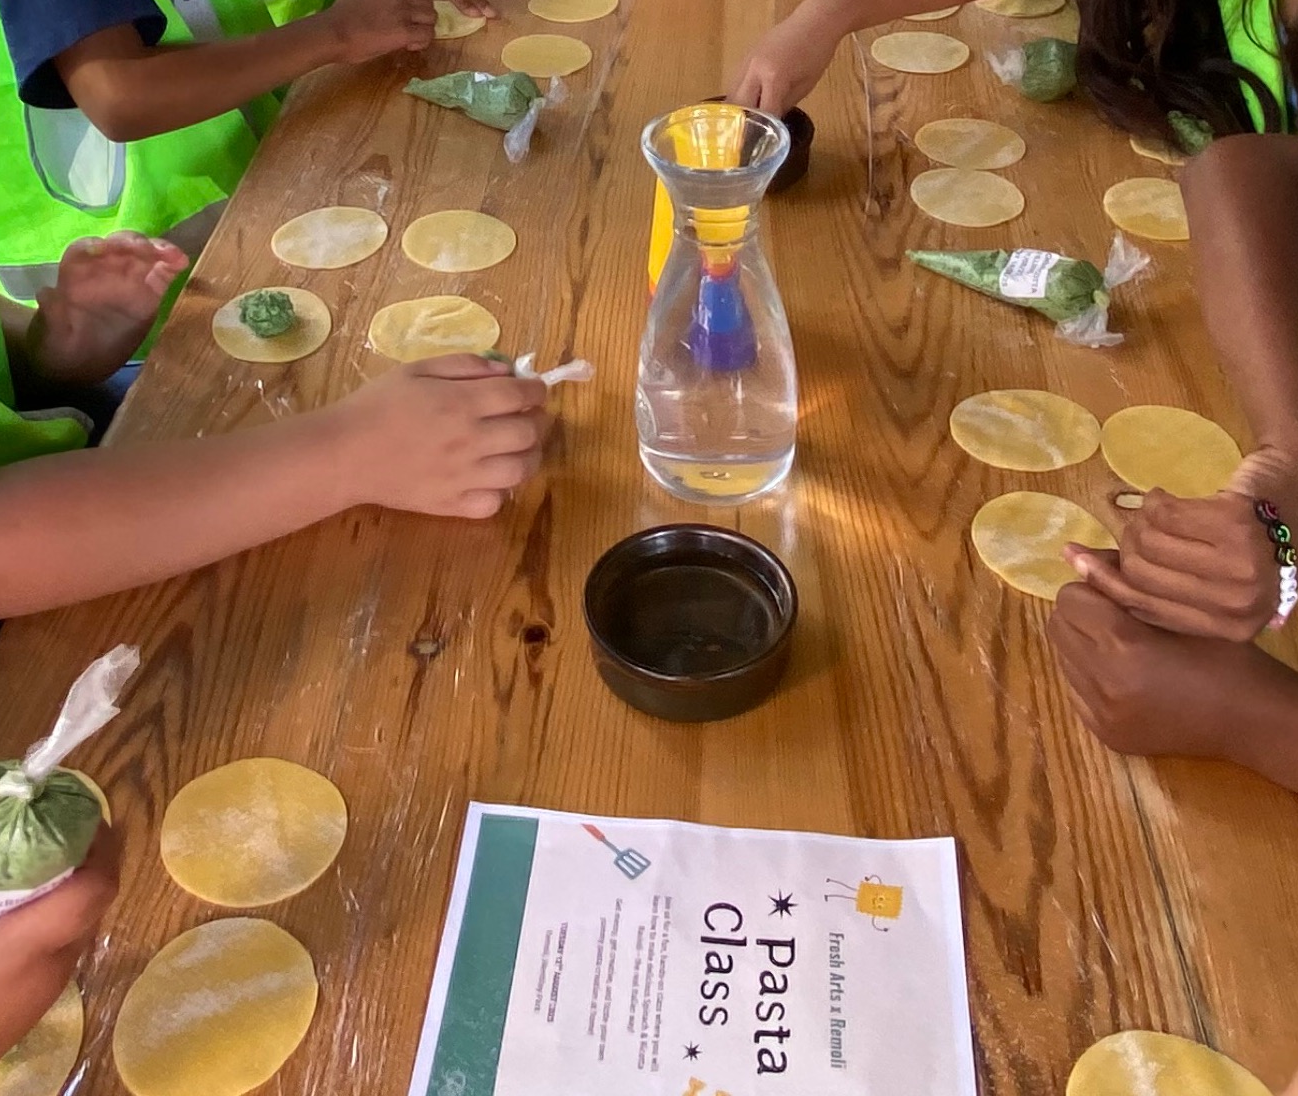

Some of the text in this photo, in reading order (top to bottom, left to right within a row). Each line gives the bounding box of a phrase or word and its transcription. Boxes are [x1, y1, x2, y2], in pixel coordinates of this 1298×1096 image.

[698, 902, 747, 1027] Class
[829, 932, 845, 968] Fresh
[754, 936, 796, 1076] Pasta
[829, 972, 844, 1001] Arts
[830, 1018, 846, 1069] Remoli
